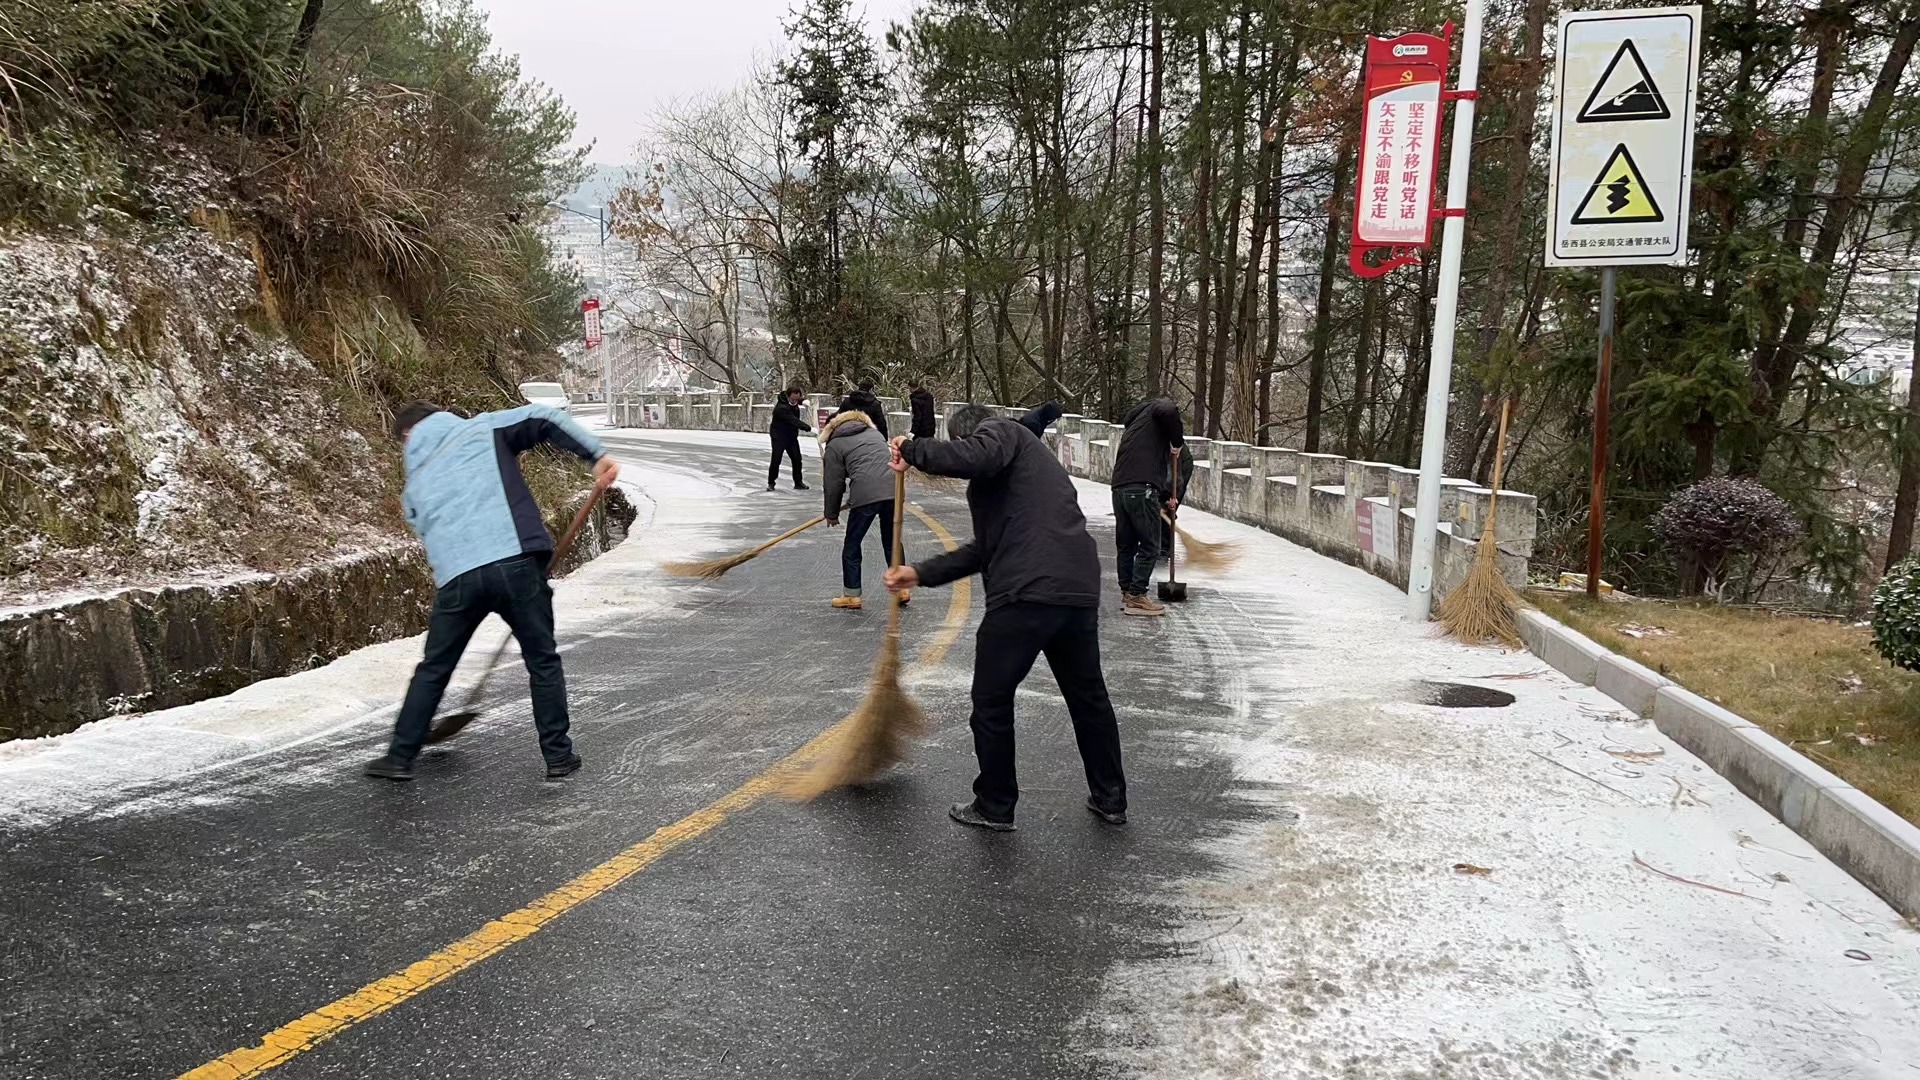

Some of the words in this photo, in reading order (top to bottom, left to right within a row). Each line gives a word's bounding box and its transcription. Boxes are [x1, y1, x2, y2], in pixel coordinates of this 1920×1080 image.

[1370, 102, 1396, 219] 矢志不渝跟党走
[1400, 102, 1425, 219] 坚定不移听党话
[1561, 236, 1671, 248] 岳西县公安局交通管理大队
